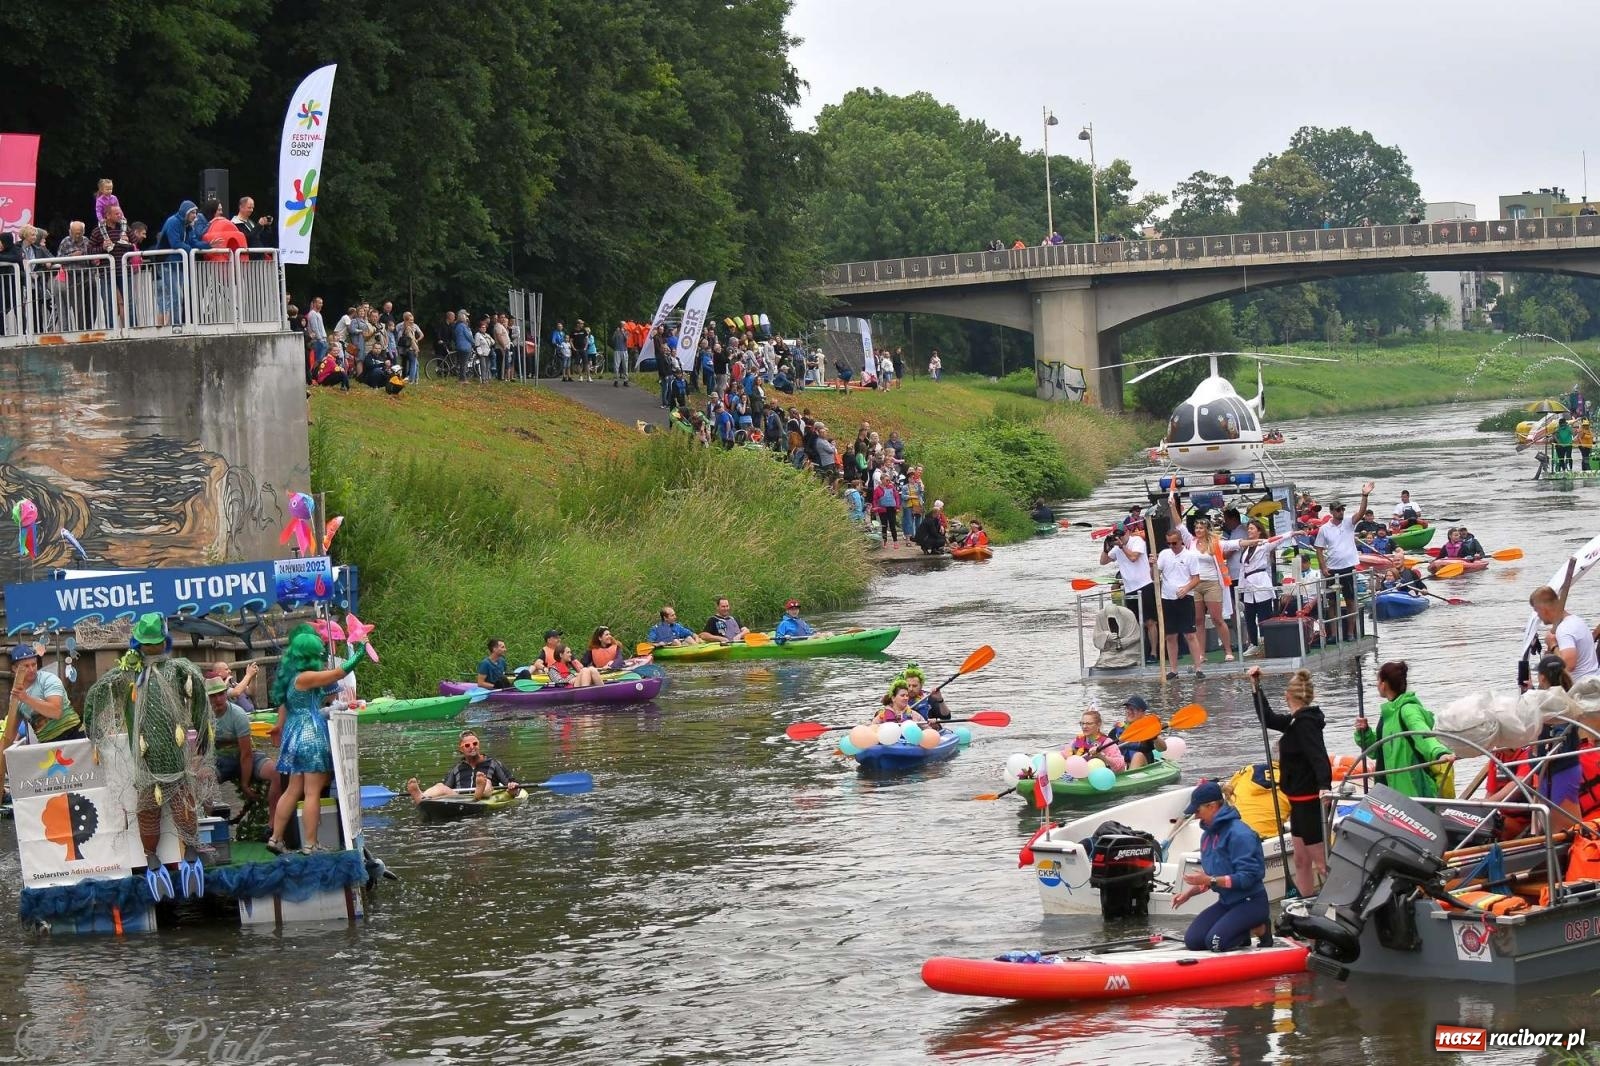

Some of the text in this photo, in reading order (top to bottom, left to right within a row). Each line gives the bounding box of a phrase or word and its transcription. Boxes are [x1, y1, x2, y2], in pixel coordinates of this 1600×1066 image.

[290, 149, 311, 157] ODRY
[305, 560, 326, 573] 2023
[55, 571, 267, 612] WESOŁE UTOPKI
[1379, 802, 1438, 842] Johnson
[1440, 808, 1486, 823] MERCURY
[1113, 847, 1152, 861] MERCURY
[32, 863, 121, 880] Stolarstwo Adrian Grzesik
[1564, 919, 1590, 943] OSP
